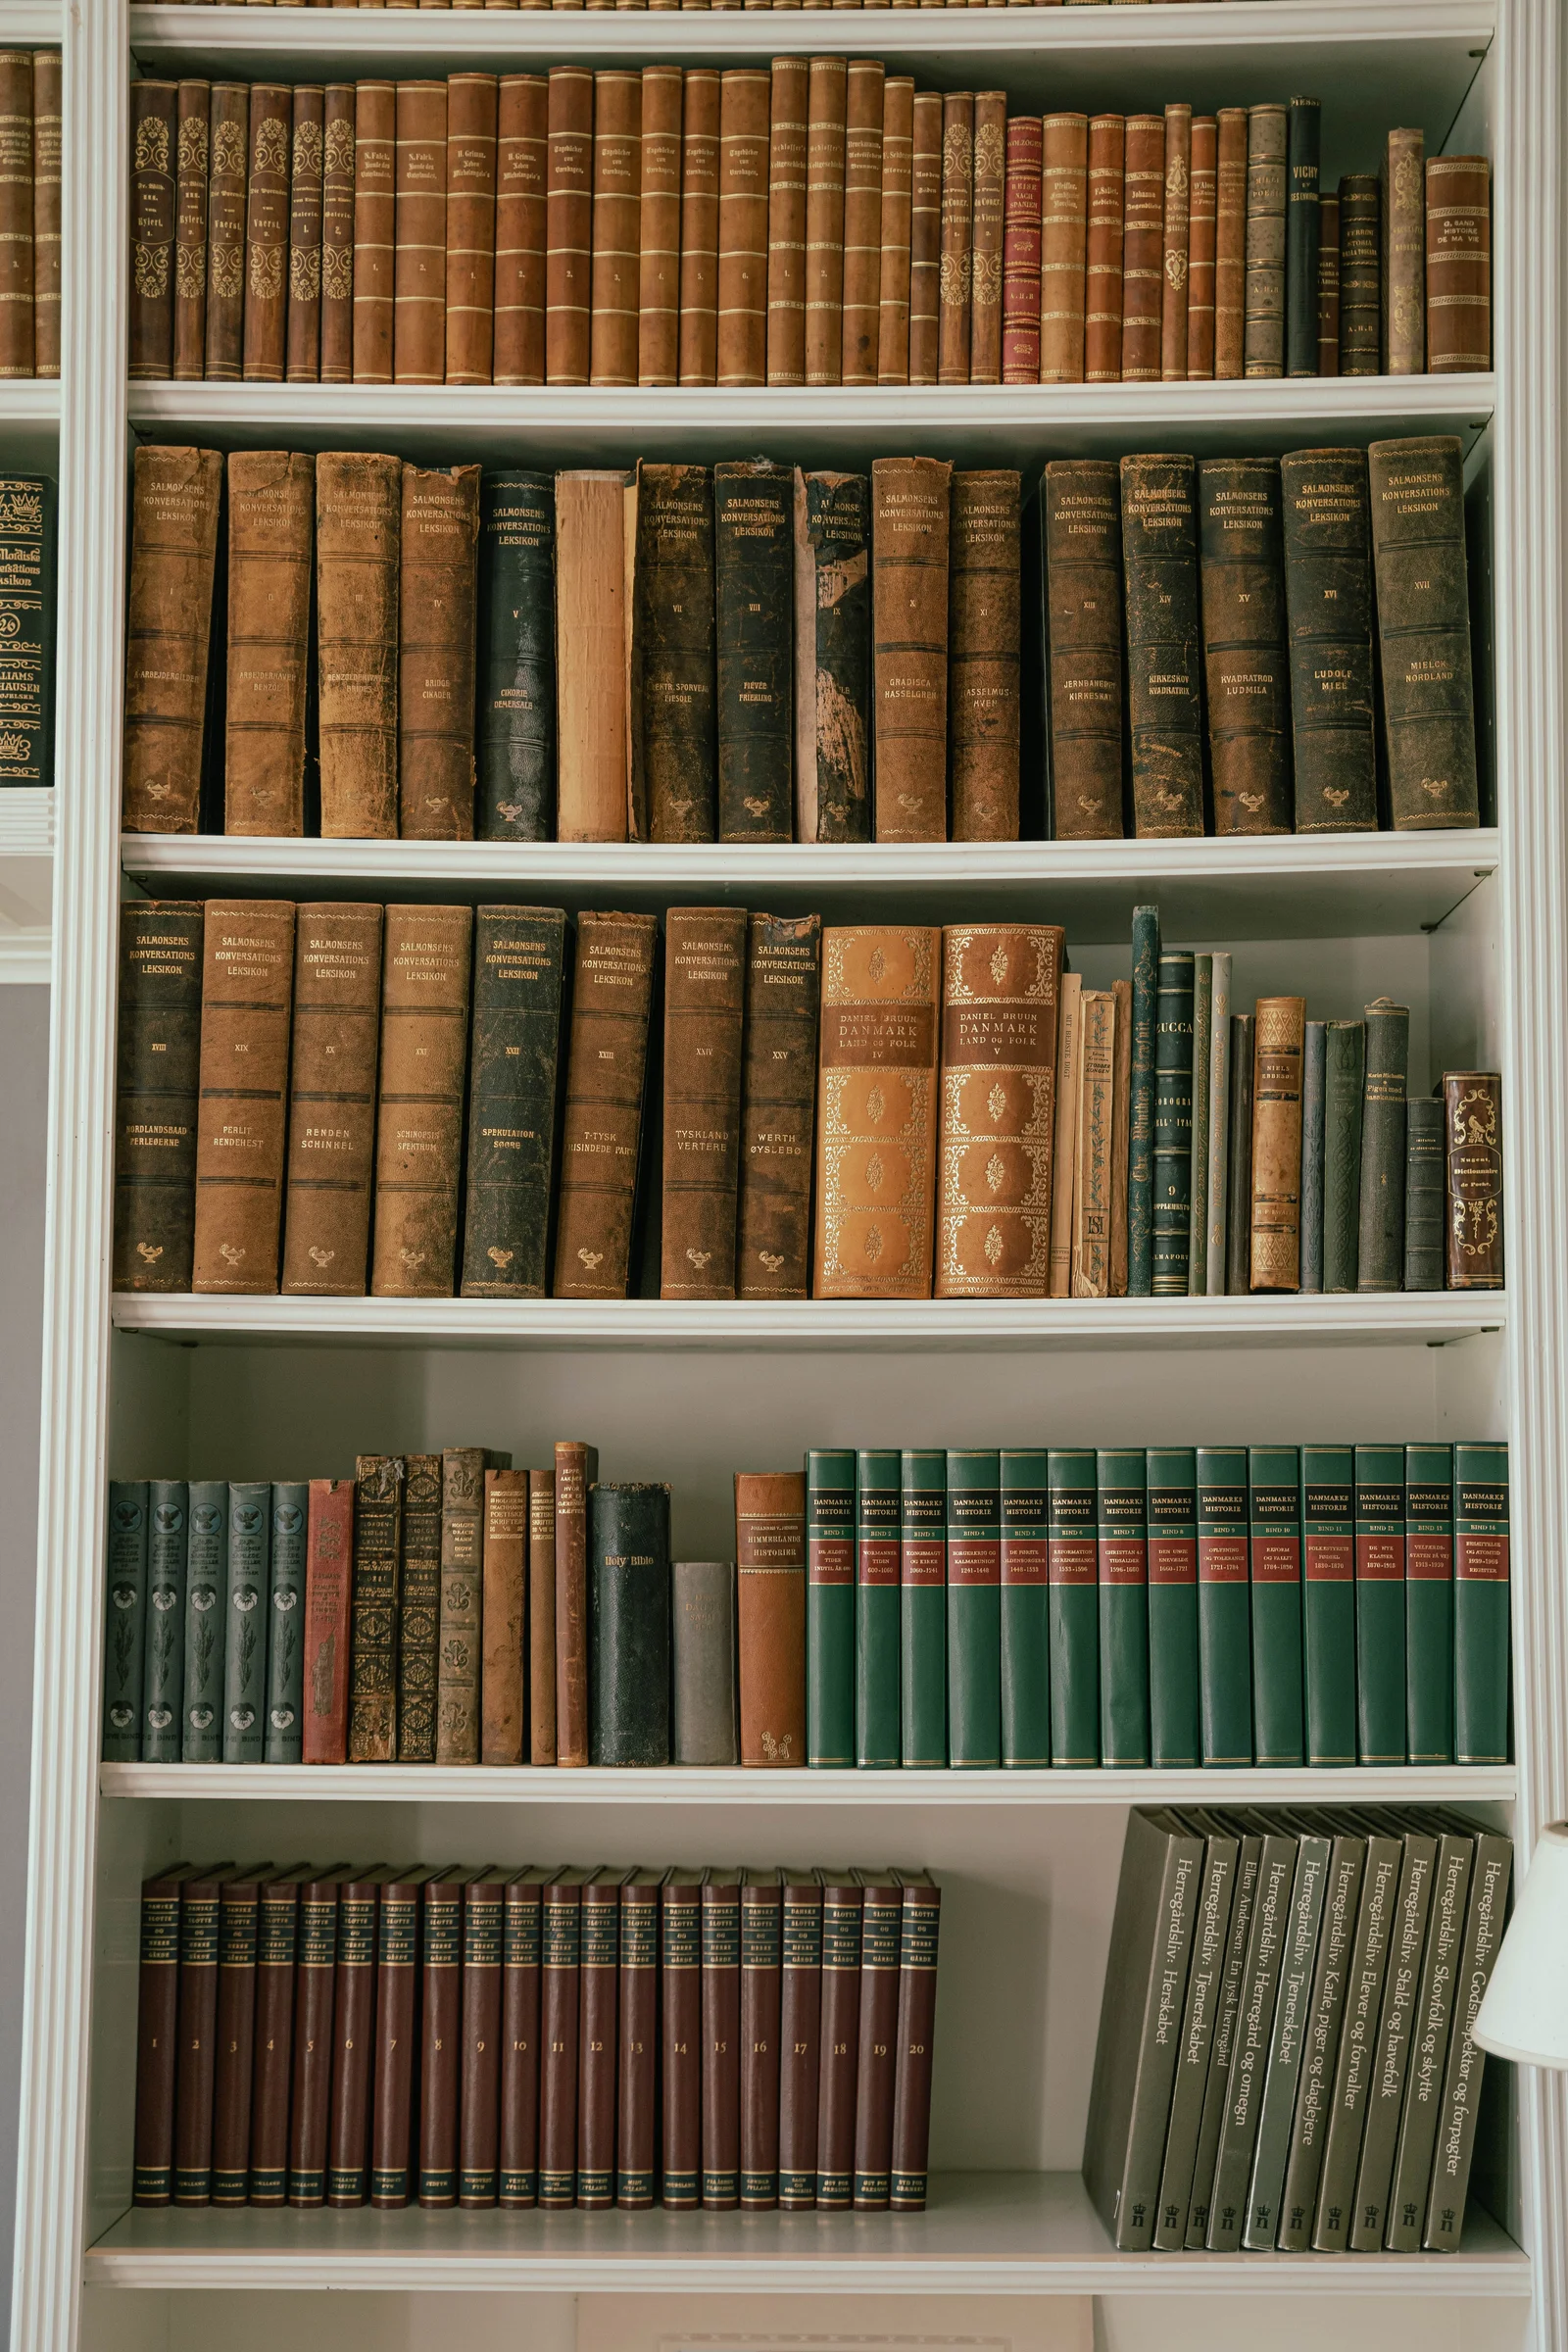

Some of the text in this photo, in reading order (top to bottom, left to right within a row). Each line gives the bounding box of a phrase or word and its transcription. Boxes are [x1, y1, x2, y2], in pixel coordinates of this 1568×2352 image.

[1293, 166, 1318, 178] VICHY
[1388, 473, 1443, 486] SALMONSENS
[886, 494, 939, 505] SALMONSENS
[1215, 491, 1268, 502] SALMONSENS
[1382, 487, 1450, 501] KONVERSATIONS
[1209, 506, 1274, 516] KONVERSATIONS
[1396, 502, 1439, 514] LEKSIKON
[879, 509, 944, 519] KONVERSATIONS
[893, 522, 932, 533] LEKSIKON
[1223, 519, 1263, 529] LEKSIKON
[1414, 580, 1430, 590] XVII
[909, 599, 916, 609] X
[1238, 594, 1250, 603] XV
[0, 617, 17, 633] 26
[1410, 660, 1447, 670] MIELCK
[889, 677, 931, 687] GRADISCA
[1221, 674, 1273, 684] KVADRATROD
[1405, 671, 1453, 683] NORDLAND
[884, 689, 937, 699] HASSELGREN
[1226, 686, 1267, 695] LUDMILA
[221, 937, 275, 948] SALMONSENS
[310, 940, 364, 950] SALMONSENS
[215, 951, 281, 962] KONVERSATIONS
[758, 946, 810, 956] SALMONSENS
[303, 954, 369, 965] KONVERSATIONS
[751, 959, 815, 970] KONVERSATIONS
[227, 966, 269, 977] LEKSIKON
[316, 968, 356, 979] LEKSIKON
[763, 974, 804, 985] LEKSIKON
[959, 1012, 1038, 1021] DANIEL BRUUN
[959, 1022, 1038, 1035] DANMARK
[959, 1036, 987, 1046] LAND
[1009, 1037, 1037, 1046] FOLK
[772, 1051, 789, 1059] XXV
[222, 1126, 252, 1135] PERLIT
[306, 1128, 350, 1138] RENDEN
[213, 1138, 264, 1148] RENDEHEST
[758, 1133, 796, 1143] WERTH
[301, 1140, 354, 1151] SCHINKEL
[750, 1145, 802, 1155] ØYSLEBØ
[1167, 1185, 1176, 1196] 9
[954, 1498, 994, 1507] DANMARKS
[1462, 1493, 1504, 1501] DANMARKS
[748, 1535, 801, 1544] HIMMERLANDS
[605, 1554, 655, 1568] Holy Bible
[1475, 1860, 1501, 1967] Herregårdsliv:
[1155, 1858, 1193, 2045] Herregårdsliv: Herskabet
[1187, 1860, 1228, 2065] Herregårdsliv: Tjenerskabet
[1216, 1861, 1257, 2067] Ellen Andersen: En jysk herregård
[1279, 1860, 1320, 2065] Herregårdsliv: Tjenerskabet
[1381, 1858, 1428, 2098] Herregårdsliv: Stald- og havefolk
[1417, 1855, 1465, 2102] Herregårdsliv: Skovfolk og skytte
[1344, 1861, 1393, 2110] Herregårdsliv: Elever og forvalter
[1234, 1861, 1287, 2126] Herregårdsliv: Herregård og omegn
[1302, 1861, 1355, 2146] Herregårdsliv: Karle, piger og daglejere
[191, 2039, 200, 2049] 2
[229, 2040, 238, 2052] 3
[267, 2038, 274, 2051] 4
[306, 2039, 315, 2052] 5
[345, 2037, 354, 2050] 6
[390, 2038, 398, 2051] 7
[434, 2038, 442, 2051] 8
[476, 2040, 485, 2053] 9
[513, 2040, 527, 2051] 10
[552, 2041, 564, 2052] 11
[590, 2040, 604, 2051] 12
[630, 2042, 643, 2054] 13
[673, 2042, 687, 2055] 14
[713, 2041, 727, 2054] 15
[754, 2040, 767, 2053] 16
[794, 2042, 808, 2055] 17
[833, 2042, 847, 2055] 18
[908, 2044, 924, 2054] 20
[873, 2044, 887, 2056] 19
[1452, 2082, 1468, 2102] og
[1446, 2104, 1470, 2177] forpagter
